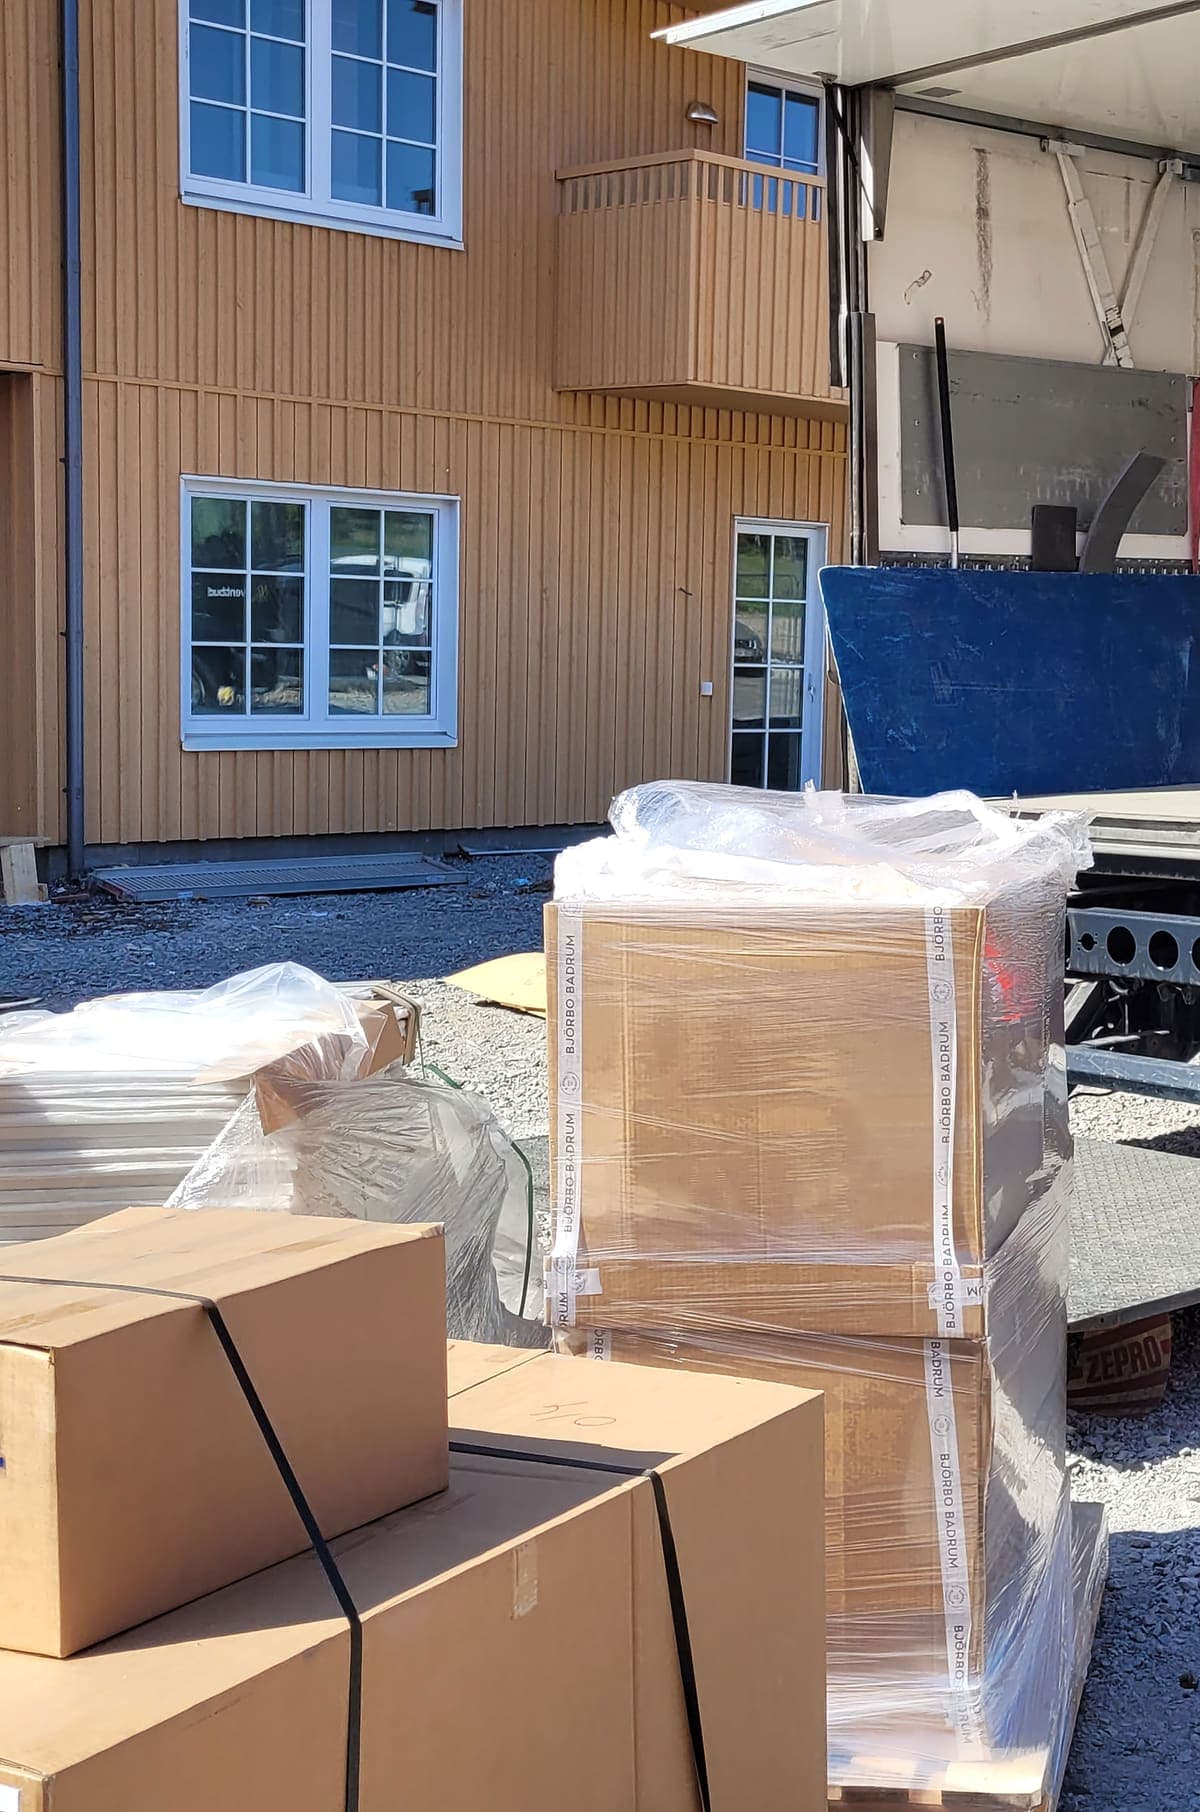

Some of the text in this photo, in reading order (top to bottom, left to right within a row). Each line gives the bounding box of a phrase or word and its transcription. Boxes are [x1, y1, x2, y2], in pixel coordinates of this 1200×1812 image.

[563, 935, 576, 1054] BJÖRBO BADRUM
[939, 1021, 951, 1081] BADRUM
[563, 1113, 575, 1233] BJÖRBO BADRUM
[942, 1271, 956, 1328] BJÖRBO
[930, 1341, 944, 1398] BADRUM
[1086, 1335, 1162, 1383] ZEPRO
[940, 1453, 954, 1507] BJÖRBO
[945, 1511, 959, 1569] BADRUM
[953, 1625, 967, 1680] BJÖRBO
